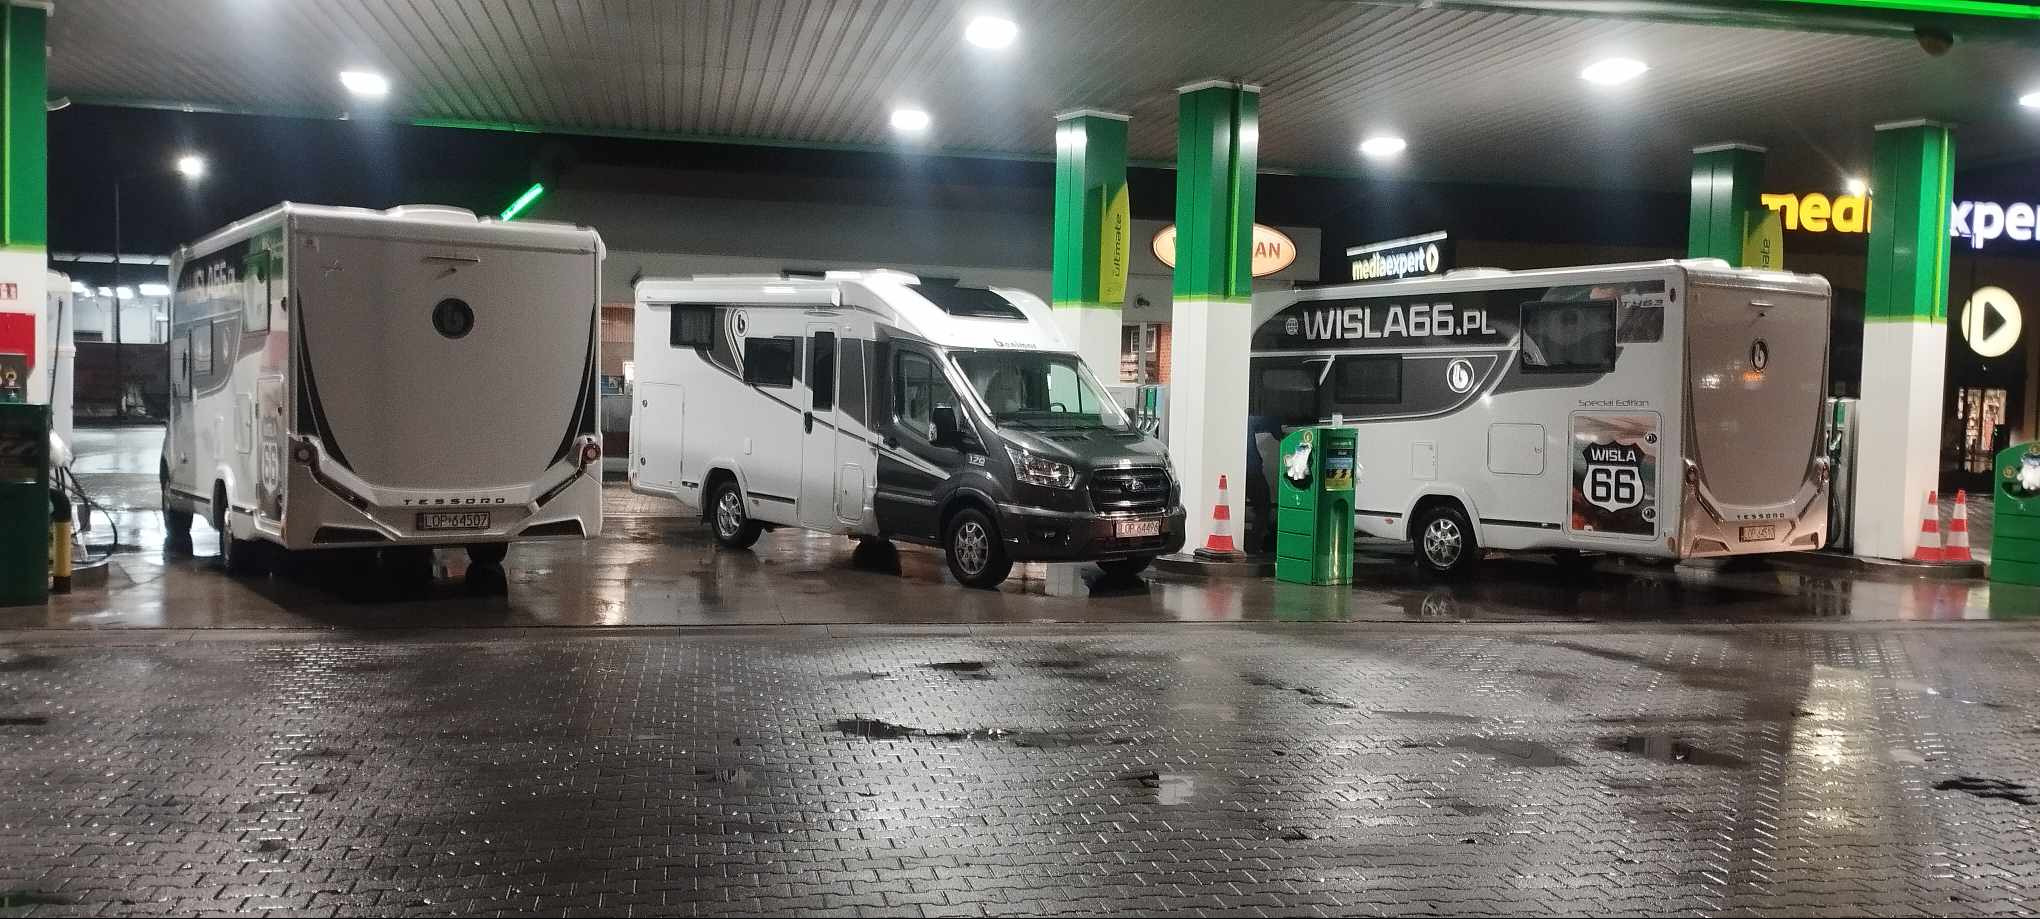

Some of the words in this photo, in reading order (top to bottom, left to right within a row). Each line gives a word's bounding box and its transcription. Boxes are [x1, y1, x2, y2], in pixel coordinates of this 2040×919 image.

[1950, 200, 2040, 249] xpe
[1352, 246, 1425, 280] mediaexpert
[1303, 304, 1497, 340] WISLA66.PL
[1578, 399, 1615, 408] Special
[1615, 399, 1649, 407] Edition
[1591, 448, 1637, 462] WISLA
[403, 497, 506, 505] TESSORO
[1591, 468, 1636, 504] 66
